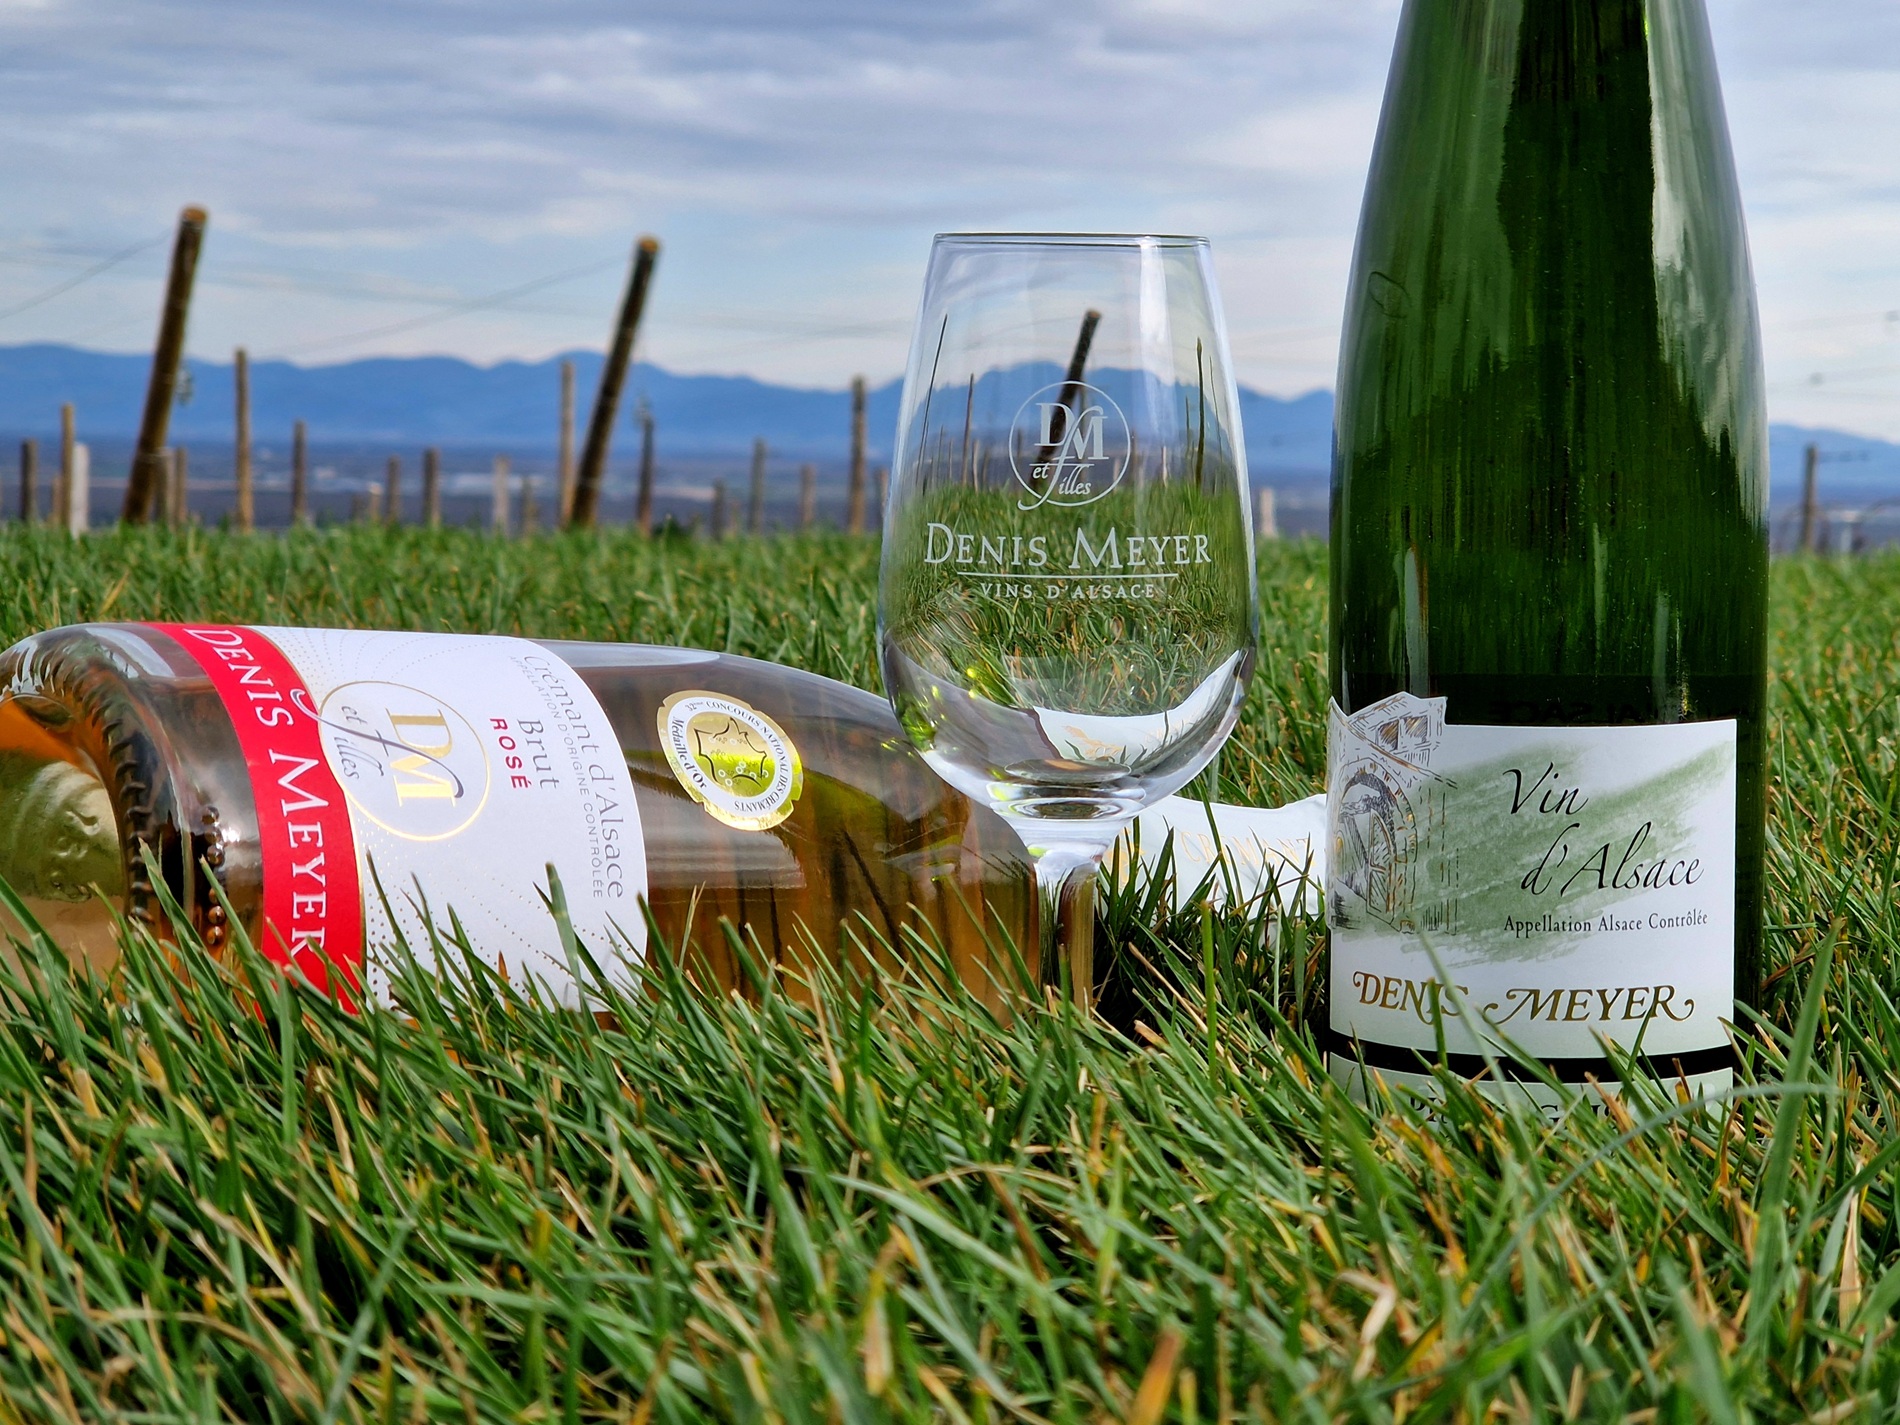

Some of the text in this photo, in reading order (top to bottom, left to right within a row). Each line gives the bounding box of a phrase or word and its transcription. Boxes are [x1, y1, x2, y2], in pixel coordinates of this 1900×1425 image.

[981, 582, 1032, 598] VINS
[490, 718, 532, 789] ROSÉ
[517, 718, 560, 789] Brut
[524, 656, 624, 898] Crémant d'Alsace
[671, 716, 707, 789] Médaille d'Or
[706, 701, 760, 727] CONCOURS
[761, 726, 789, 773] NATIONAL
[776, 774, 788, 795] DES
[1502, 761, 1590, 815] Vin
[1520, 821, 1705, 898] d'Alsace
[1503, 908, 1708, 939] Appellation Alsace Contrôlée
